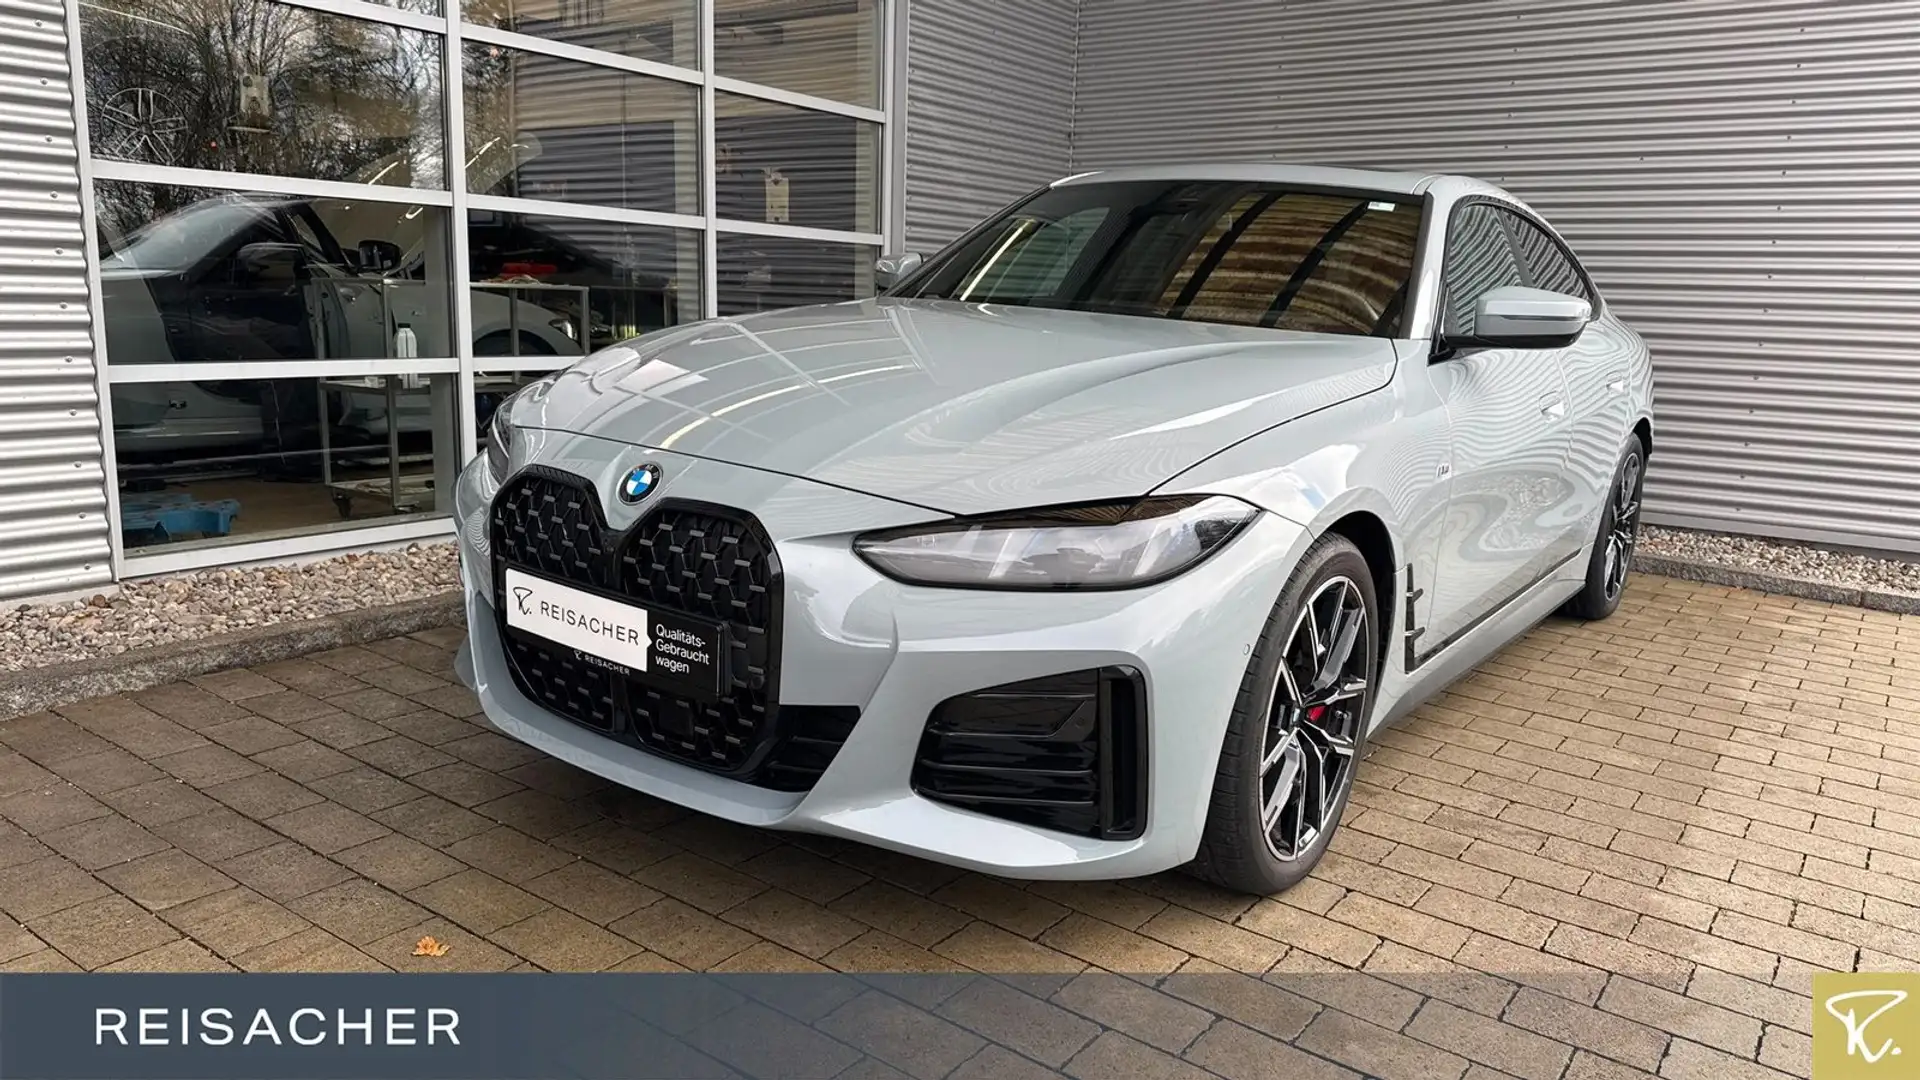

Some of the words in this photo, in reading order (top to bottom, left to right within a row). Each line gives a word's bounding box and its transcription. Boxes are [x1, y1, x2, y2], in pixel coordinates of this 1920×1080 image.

[540, 601, 639, 646] REISACHER
[656, 623, 706, 647] Qualitäts-
[656, 638, 710, 665] Gebraucht
[585, 654, 630, 676] REISACHER
[655, 655, 690, 674] wagen
